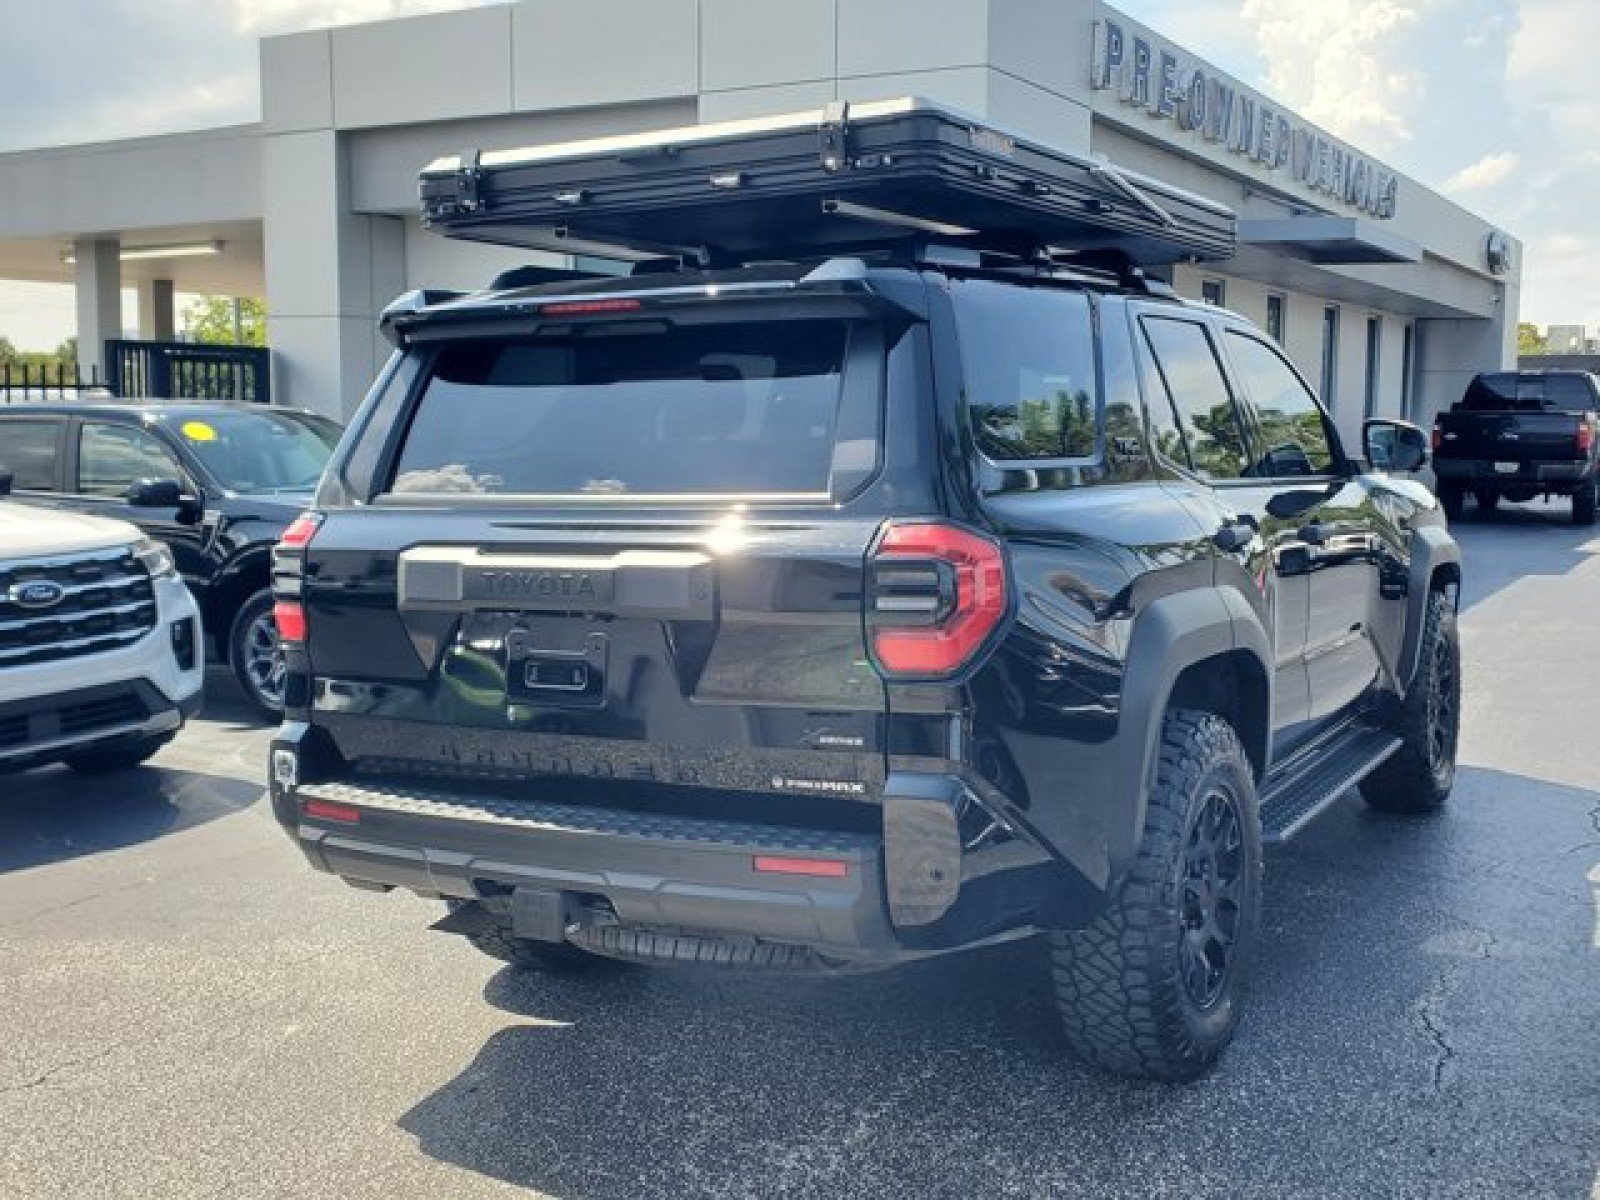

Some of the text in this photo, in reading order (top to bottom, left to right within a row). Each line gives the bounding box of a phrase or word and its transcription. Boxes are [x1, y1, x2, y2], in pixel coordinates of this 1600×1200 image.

[1094, 18, 1397, 220] PRE-OWNED VEHICLES
[480, 571, 593, 596] TOYOTA
